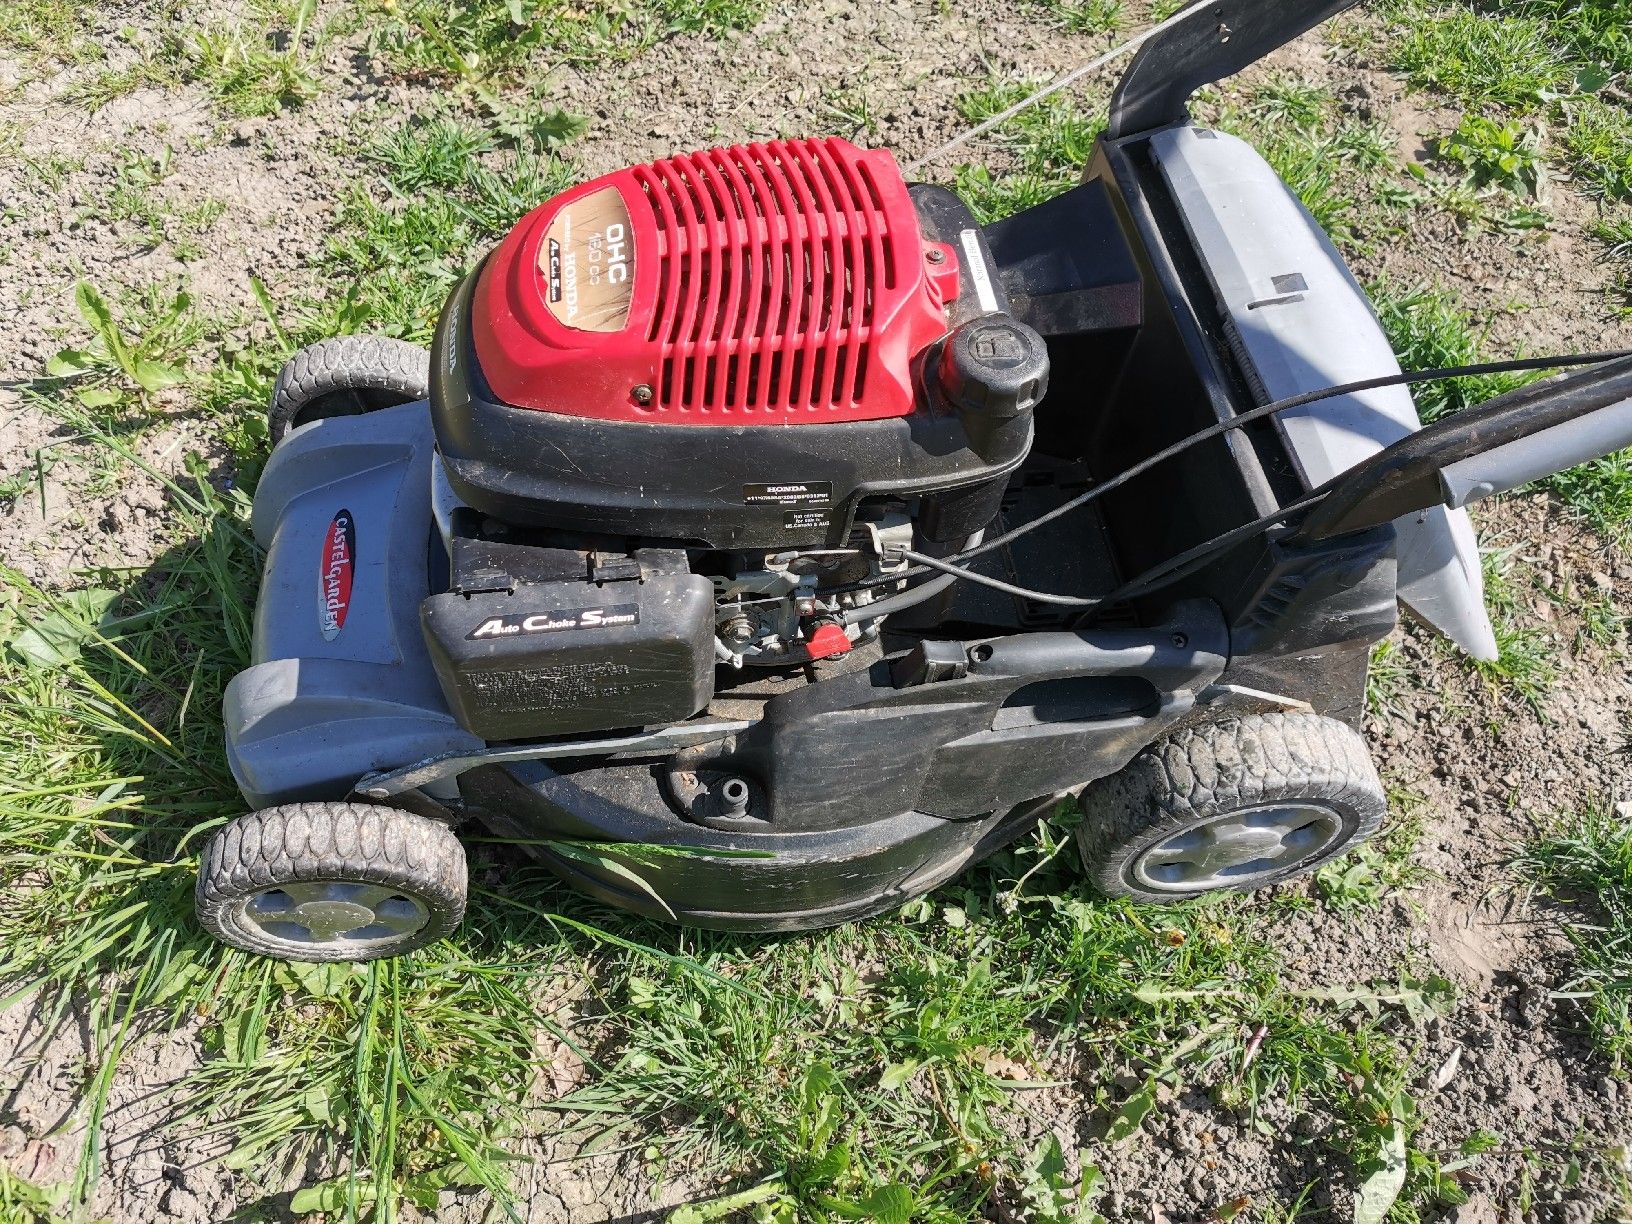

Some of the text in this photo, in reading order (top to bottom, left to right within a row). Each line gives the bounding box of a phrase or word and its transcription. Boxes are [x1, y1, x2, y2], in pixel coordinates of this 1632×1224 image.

[606, 223, 627, 284] OHC
[564, 253, 577, 321] HONDA
[450, 305, 459, 375] HONDA
[473, 610, 635, 637] Auto Choke System
